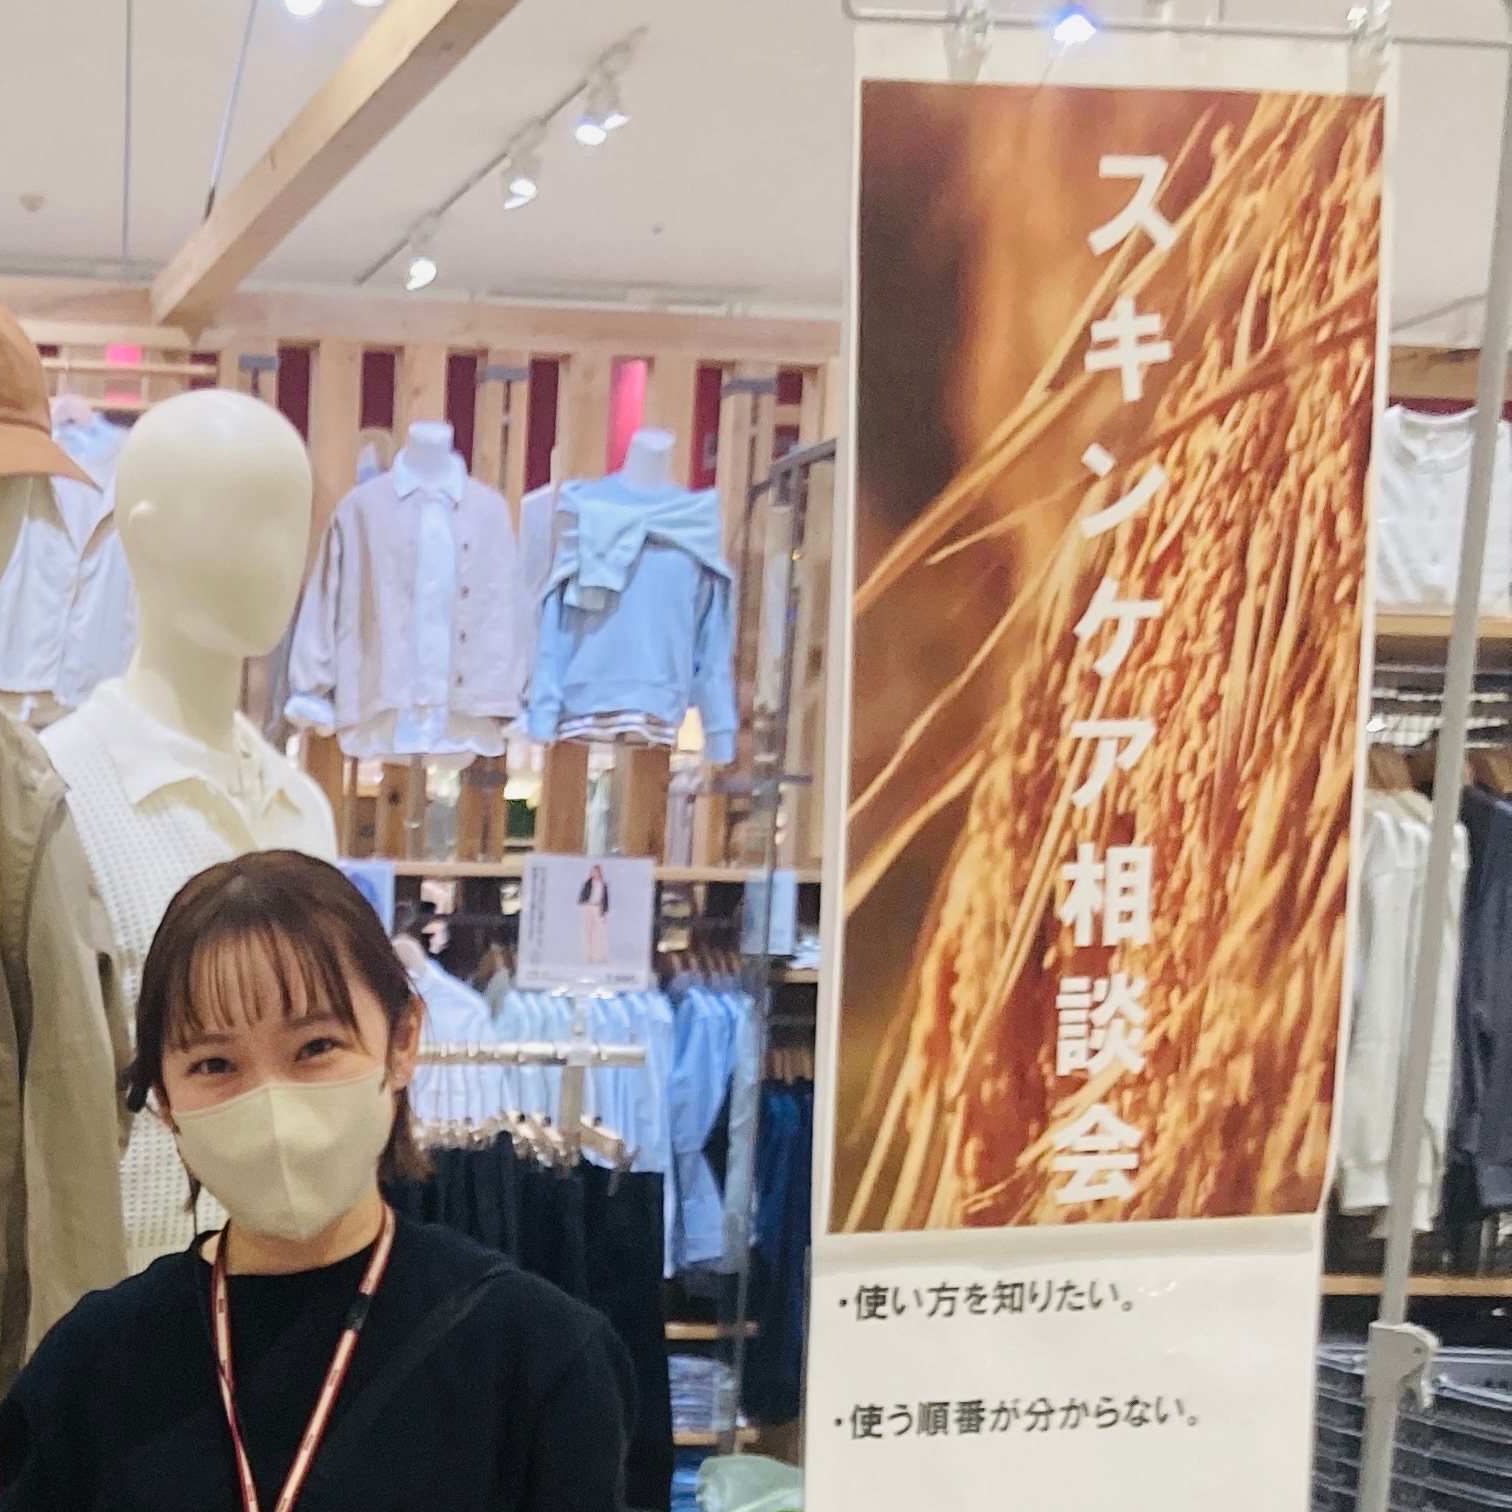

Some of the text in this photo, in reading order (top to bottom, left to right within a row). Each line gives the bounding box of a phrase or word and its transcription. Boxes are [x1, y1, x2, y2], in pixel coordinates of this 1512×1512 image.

[1052, 154, 1178, 1206] スキンケア相談会
